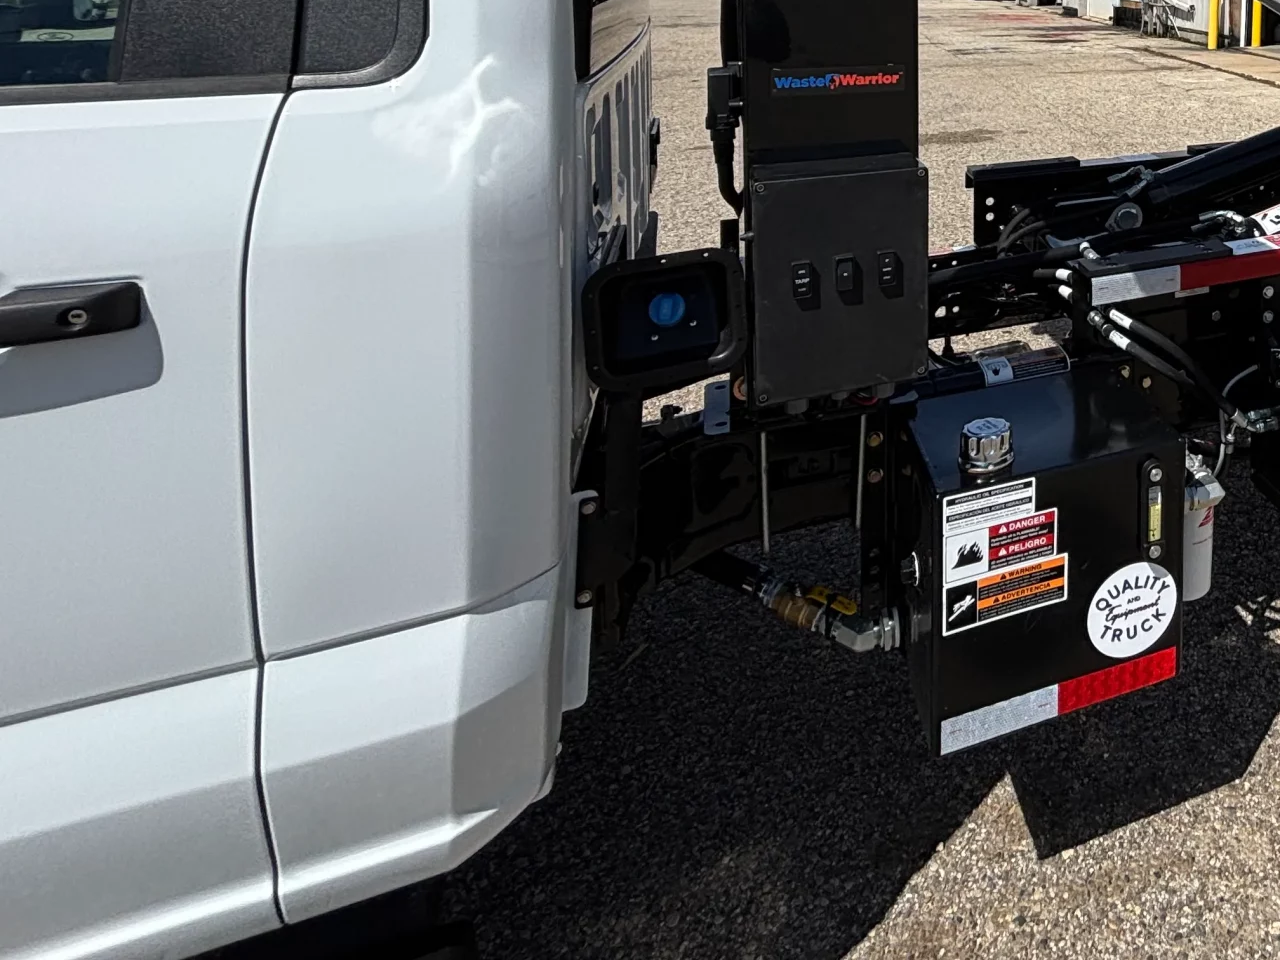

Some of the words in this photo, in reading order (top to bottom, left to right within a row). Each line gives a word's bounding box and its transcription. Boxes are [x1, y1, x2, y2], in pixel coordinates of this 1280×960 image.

[774, 76, 826, 89] Waste
[840, 73, 899, 87] Warrior
[795, 277, 810, 285] TARP
[1008, 515, 1046, 531] DANGER
[1008, 537, 1047, 554] PELIGRO
[1008, 563, 1043, 578] WARNING
[1001, 582, 1051, 601] ADVERTENCIA
[1095, 575, 1170, 612] QUALITY
[1127, 595, 1141, 605] AND
[1105, 595, 1162, 626] Equipment
[1100, 607, 1167, 643] TRUCK
